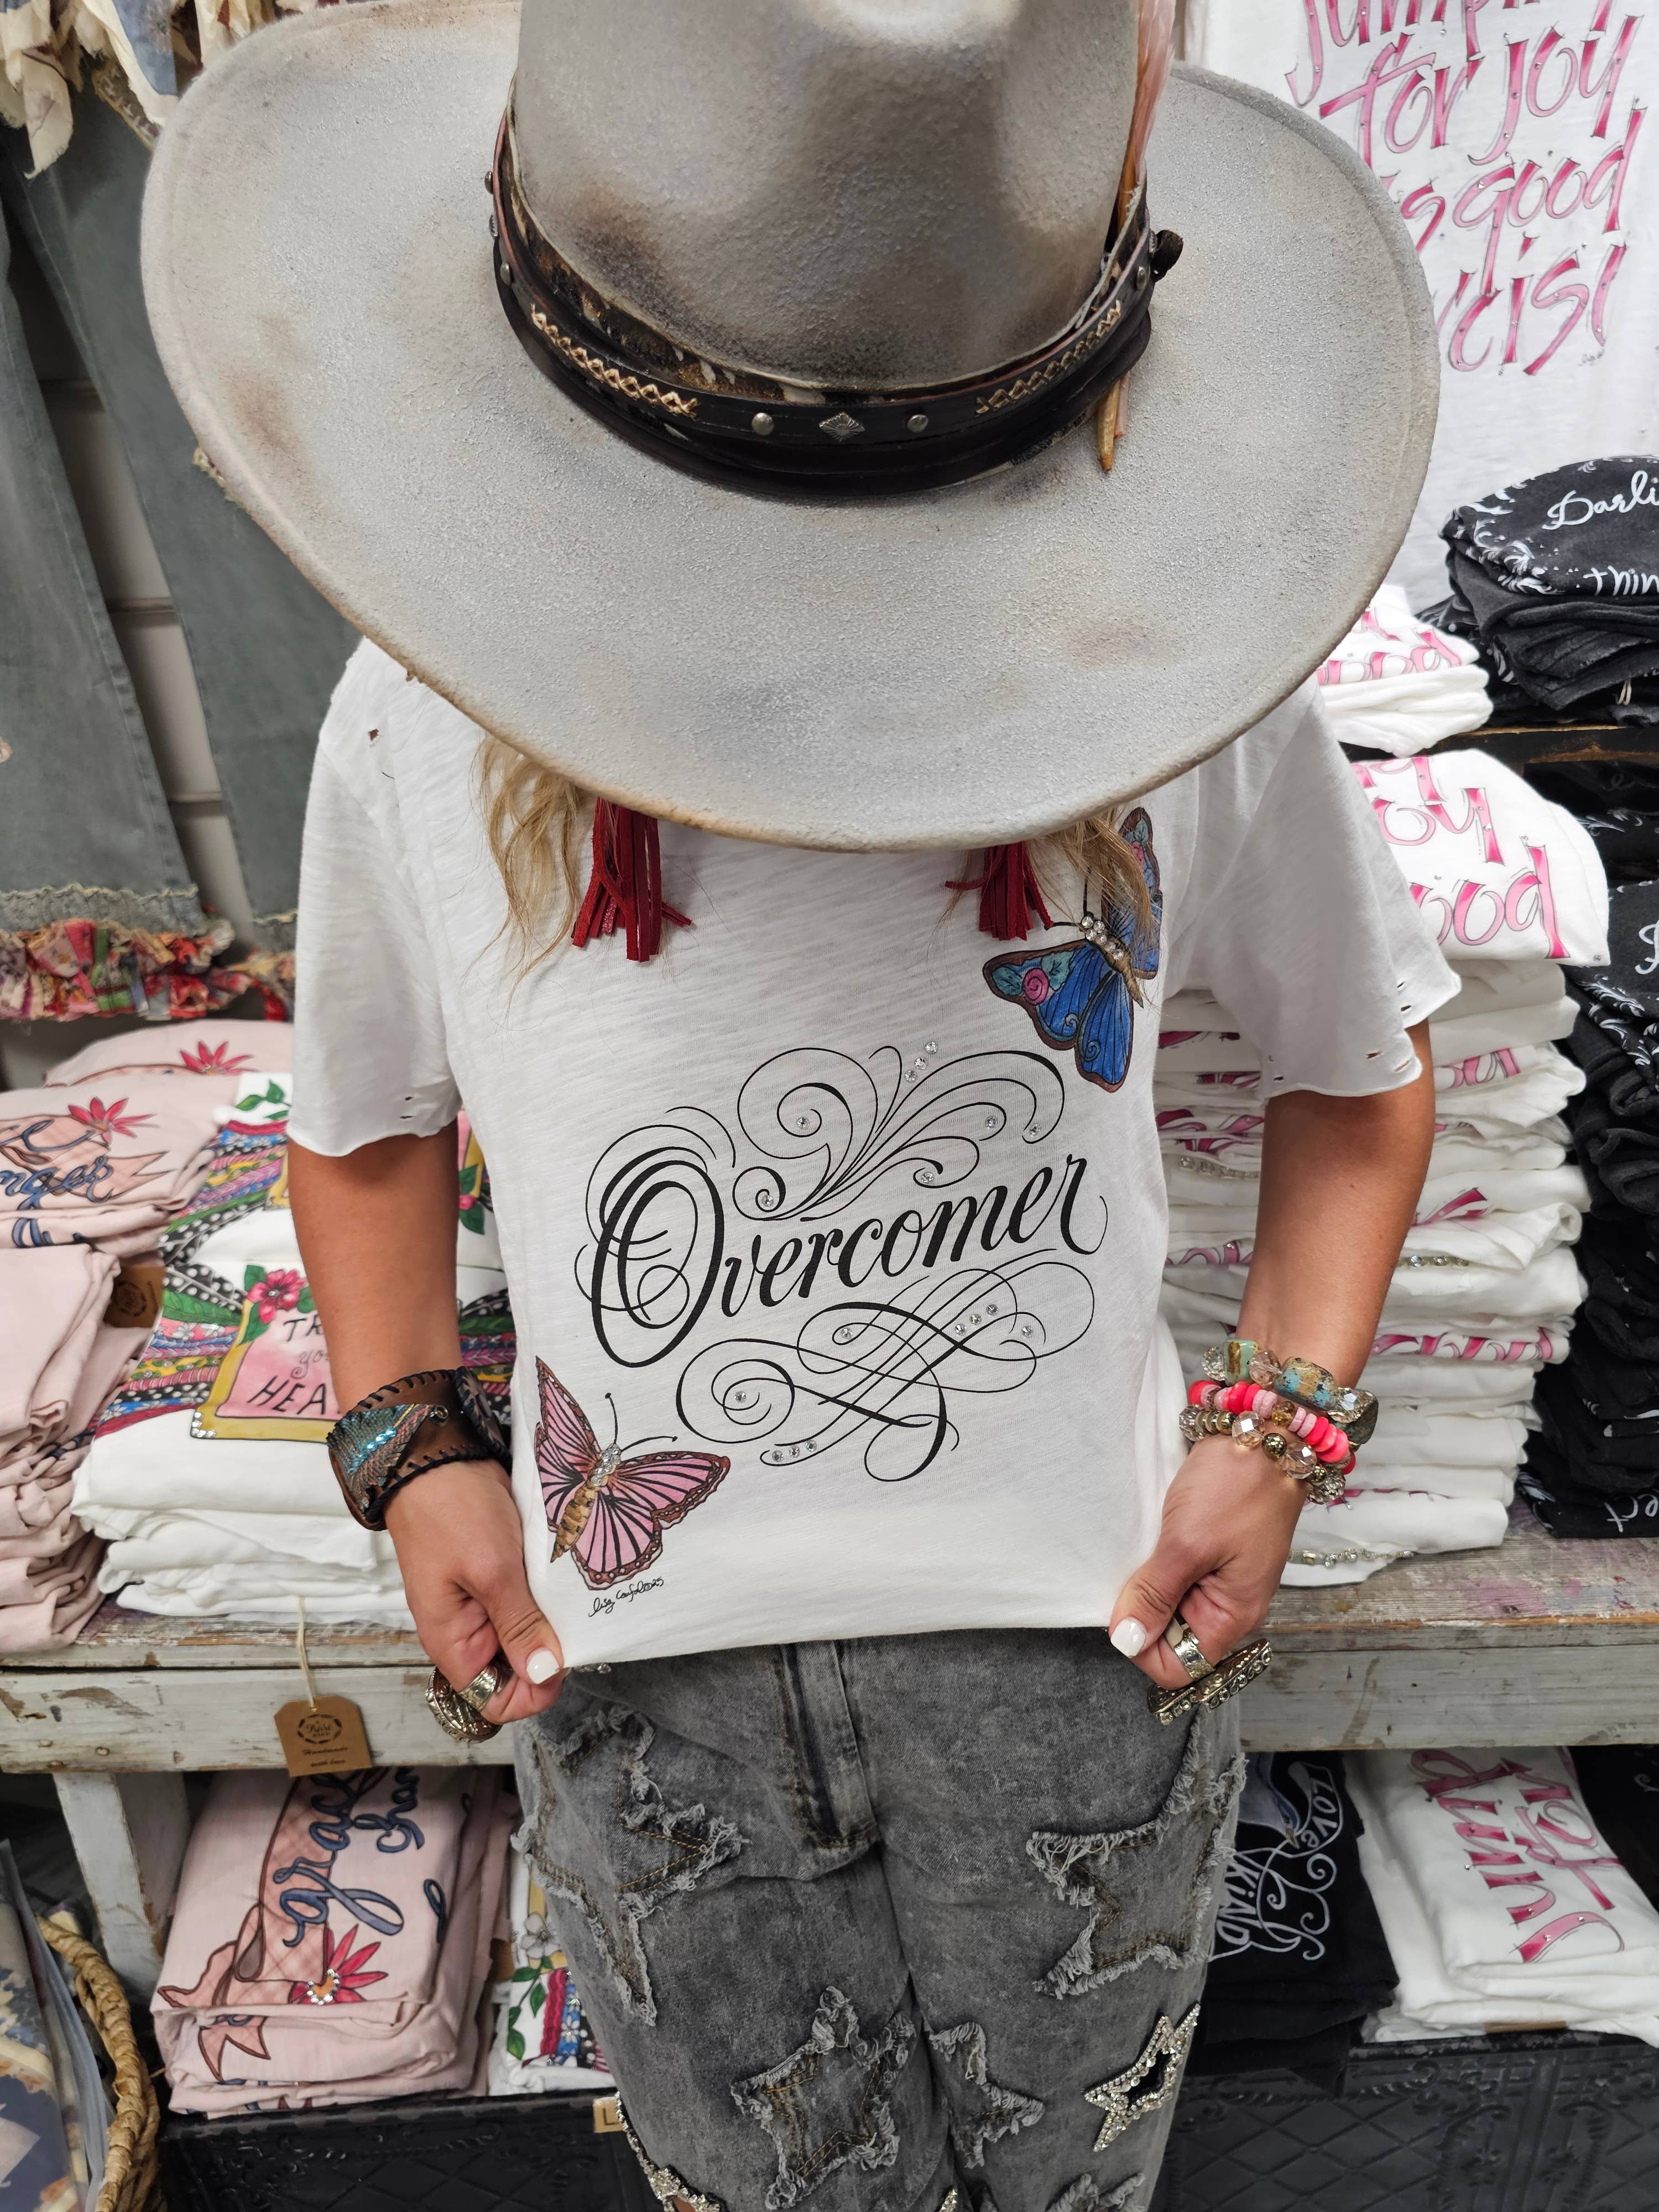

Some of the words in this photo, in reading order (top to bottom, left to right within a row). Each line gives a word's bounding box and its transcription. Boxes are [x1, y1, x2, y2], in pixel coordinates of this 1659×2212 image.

[1319, 33, 1485, 170] for
[1452, 105, 1647, 296] good
[1371, 787, 1506, 866] oy
[1410, 838, 1571, 959] ood
[583, 1145, 1108, 1368] Overcomer
[246, 1375, 341, 1416] HEA
[290, 1349, 330, 1379] yo
